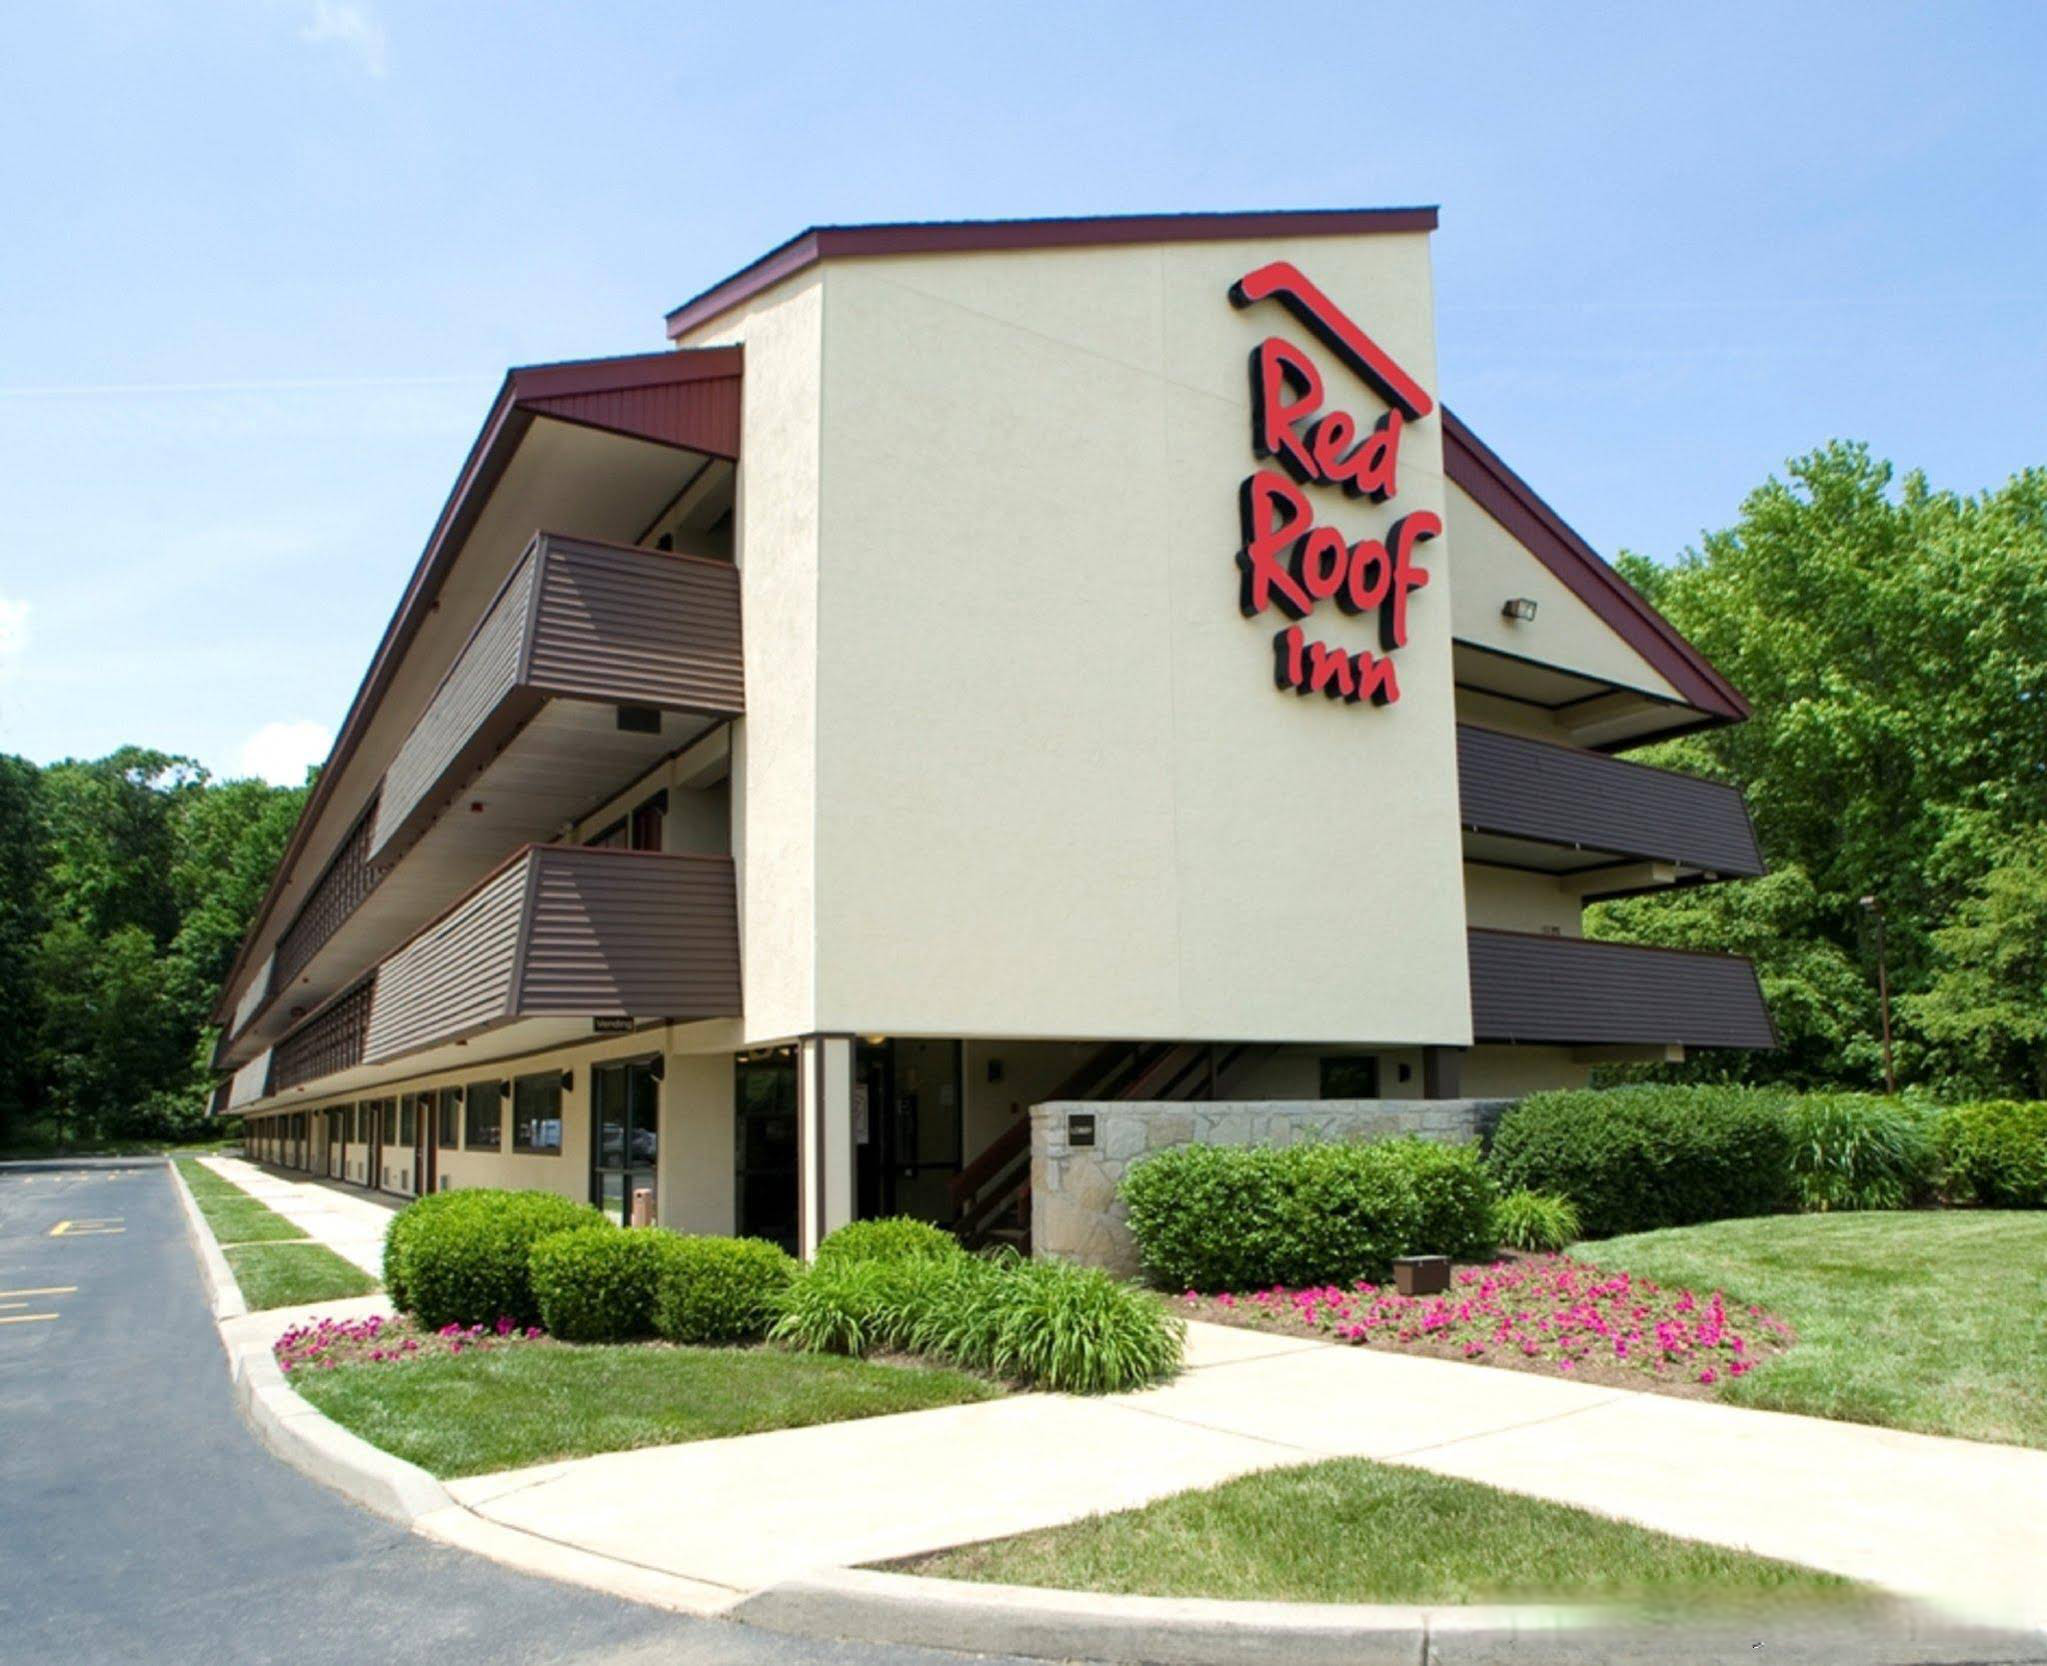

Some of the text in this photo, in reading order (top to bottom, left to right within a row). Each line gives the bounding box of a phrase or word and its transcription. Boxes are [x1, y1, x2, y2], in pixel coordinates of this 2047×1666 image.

[1261, 336, 1404, 496] Red
[1247, 469, 1442, 648] Roof
[1287, 625, 1400, 703] Inn
